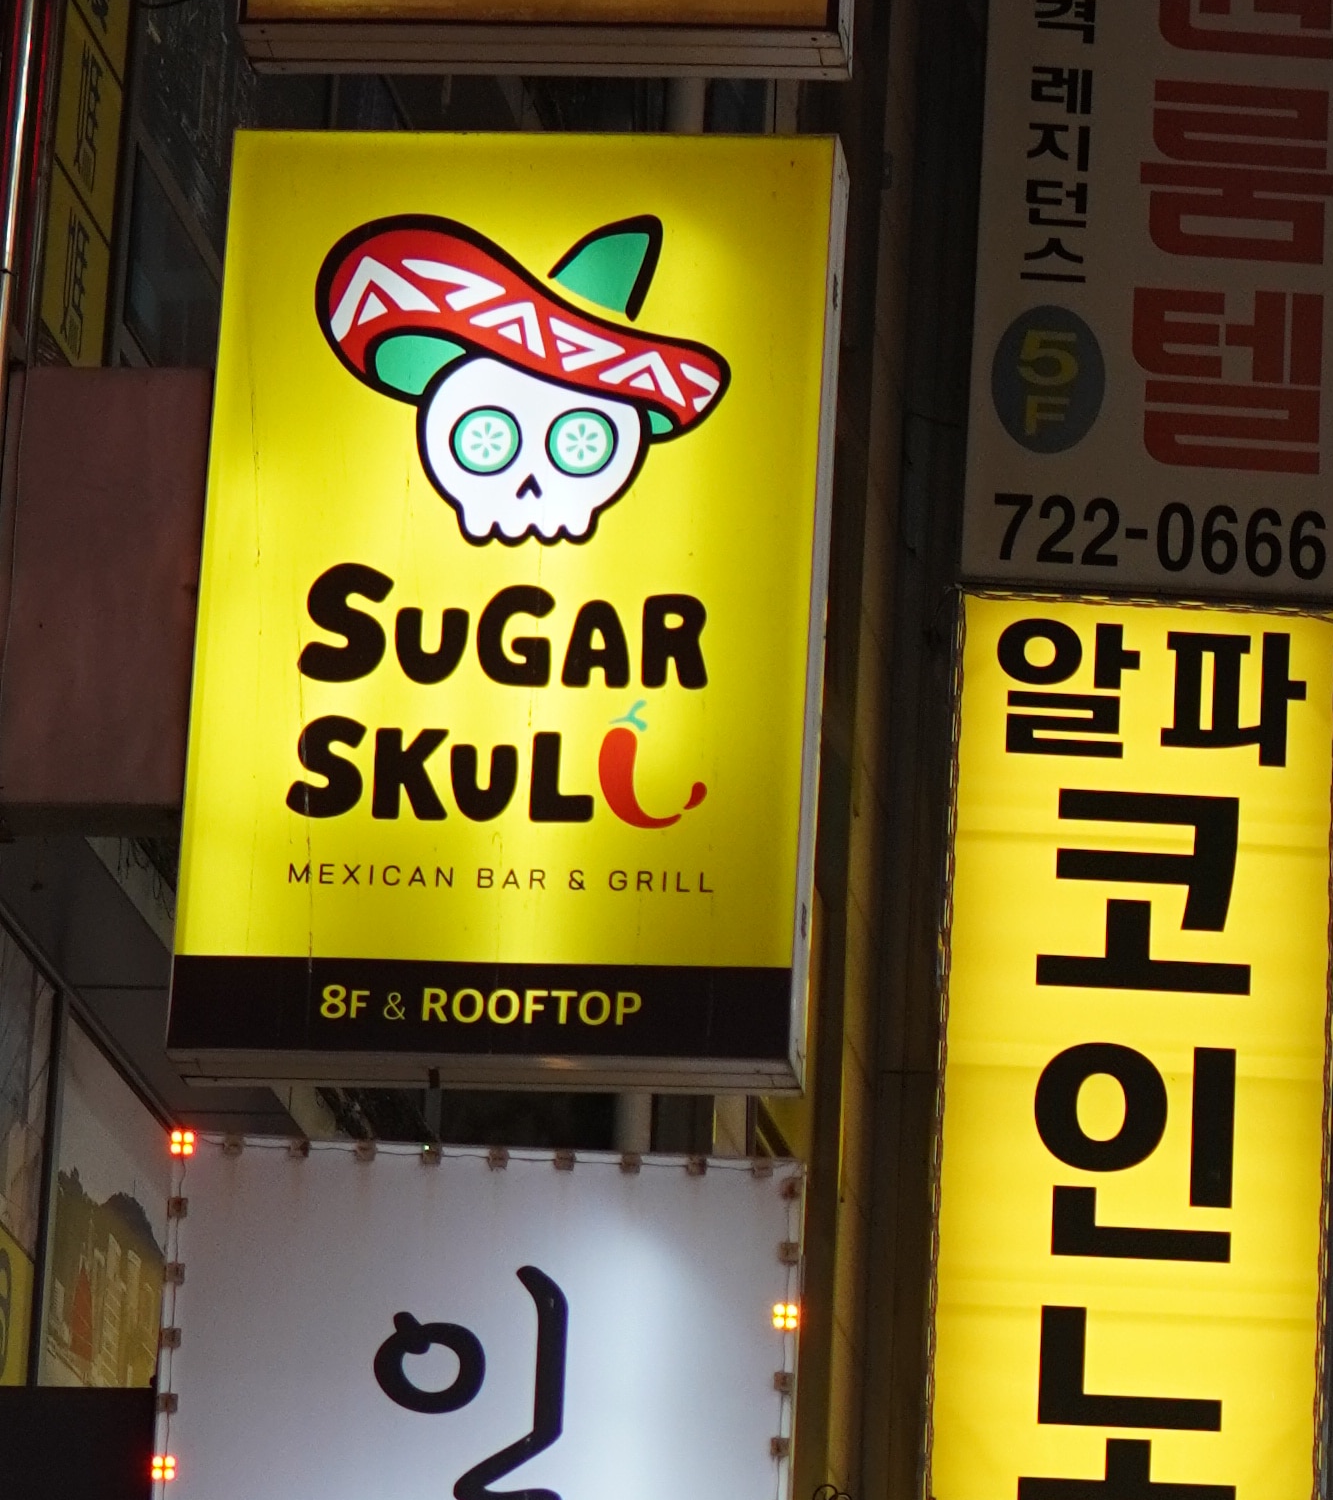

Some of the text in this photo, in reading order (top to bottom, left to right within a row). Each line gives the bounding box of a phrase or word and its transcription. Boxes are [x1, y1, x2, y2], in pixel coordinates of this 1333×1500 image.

[1019, 66, 1093, 285] 레지던스
[1016, 328, 1080, 437] 5F
[993, 494, 1328, 581] 722-0666
[997, 617, 1307, 768] 알파
[288, 863, 714, 894] MEXICAN BAR & GRILL
[320, 985, 643, 1026] 8F & ROOFTOP
